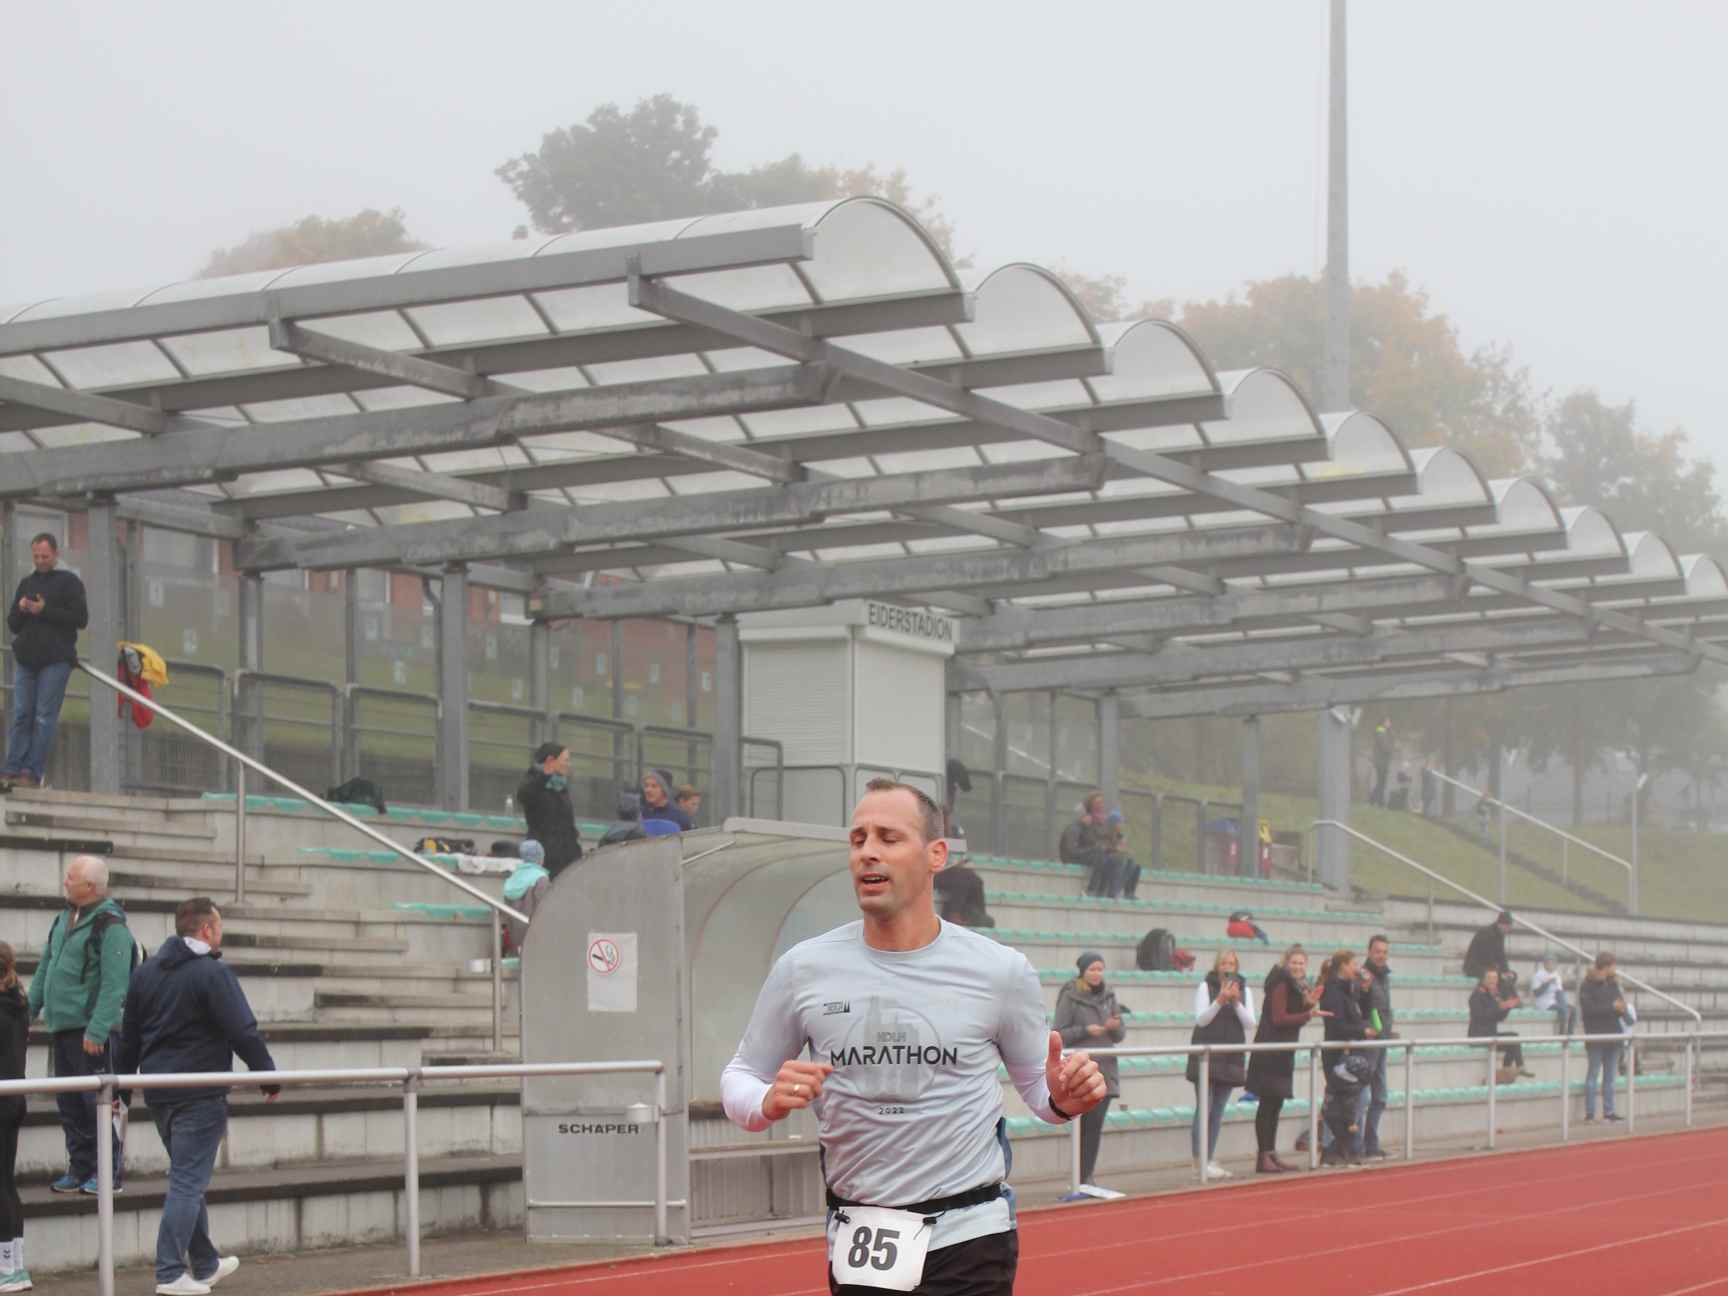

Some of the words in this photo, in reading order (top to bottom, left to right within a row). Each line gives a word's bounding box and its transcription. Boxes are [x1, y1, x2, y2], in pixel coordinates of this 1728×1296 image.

[868, 603, 953, 641] EIDERSTADION
[831, 1045, 958, 1066] MARATHON
[848, 1226, 900, 1271] 85
